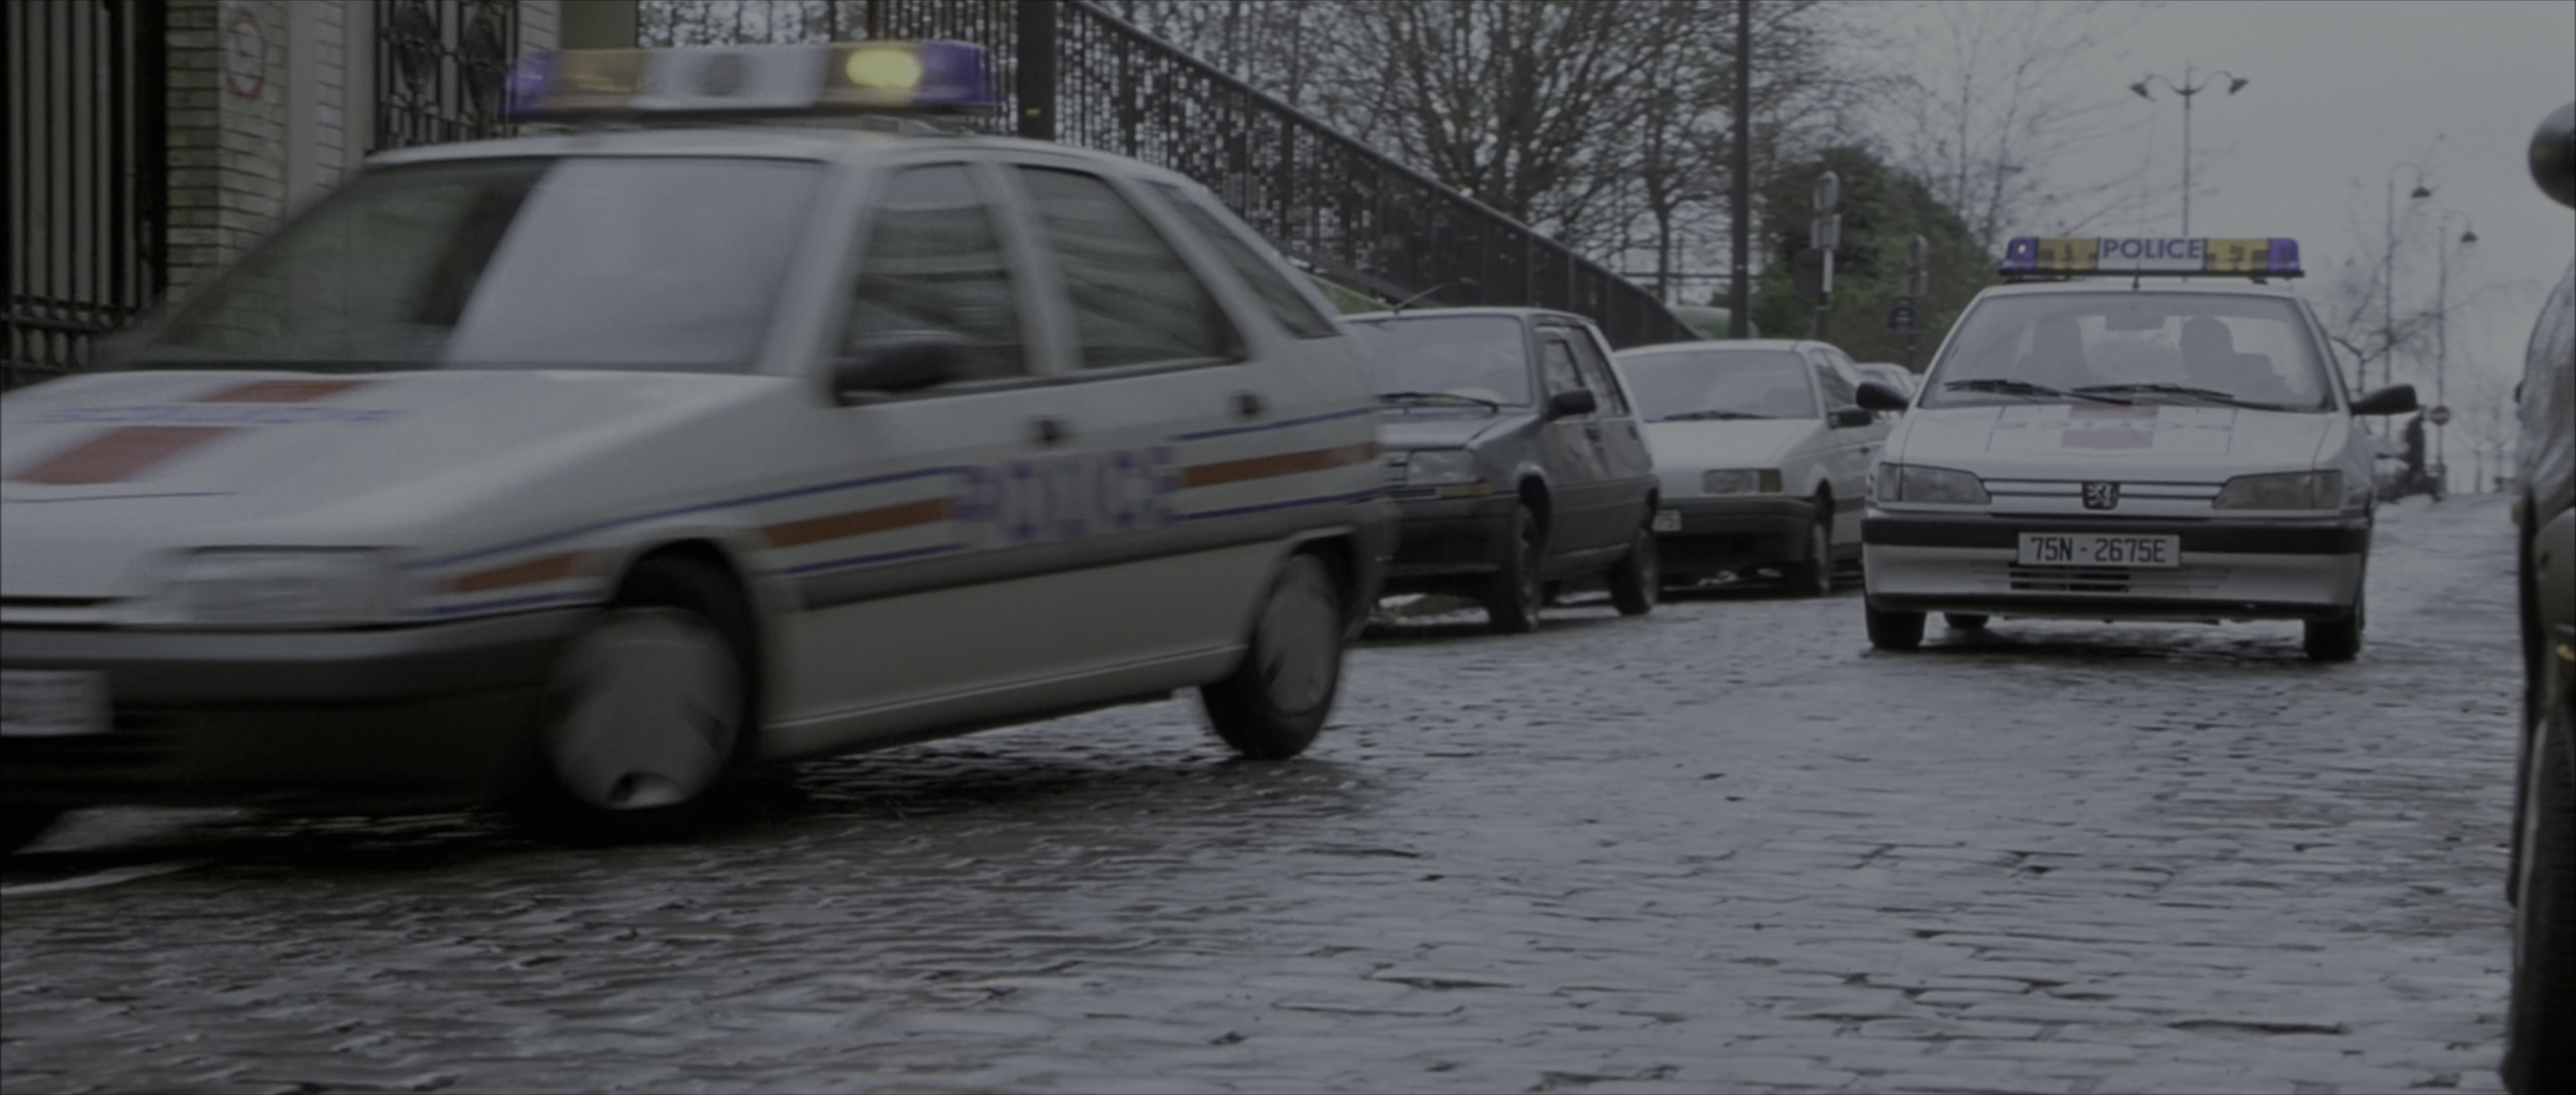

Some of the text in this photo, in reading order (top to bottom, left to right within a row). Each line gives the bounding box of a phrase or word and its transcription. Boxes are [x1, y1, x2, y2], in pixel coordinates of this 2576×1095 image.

[2102, 238, 2201, 259] POLICE
[957, 447, 1179, 541] POLICE
[2031, 537, 2073, 562] 75N
[2094, 538, 2167, 563] 2675E
